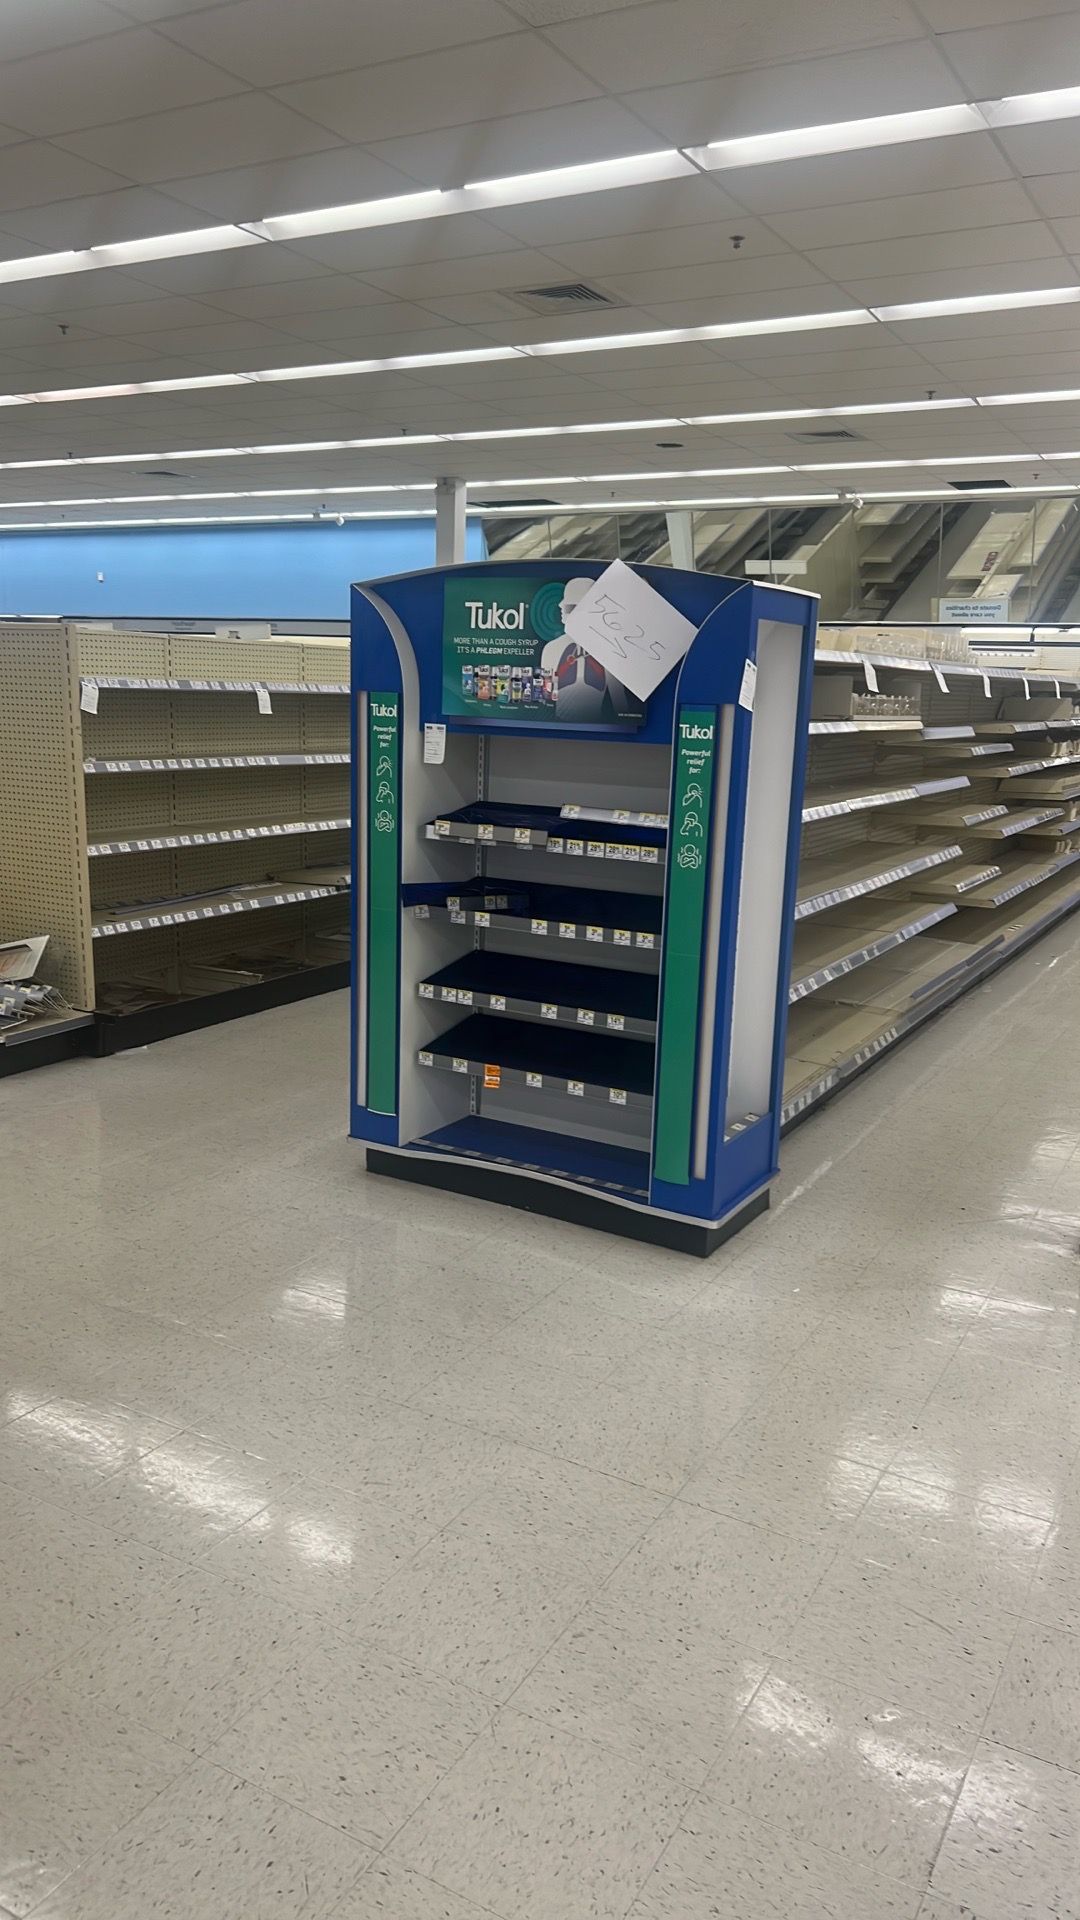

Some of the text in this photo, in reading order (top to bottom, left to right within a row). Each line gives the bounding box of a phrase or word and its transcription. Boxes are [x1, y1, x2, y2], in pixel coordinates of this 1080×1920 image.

[465, 602, 525, 630] Tukol
[453, 637, 471, 645] MORE
[457, 646, 469, 654] IT'S
[476, 647, 502, 655] PHLEGM
[503, 648, 535, 656] EXPELLER
[370, 704, 397, 717] Tukol
[679, 724, 713, 739] Tukol
[682, 749, 711, 757] Powerful
